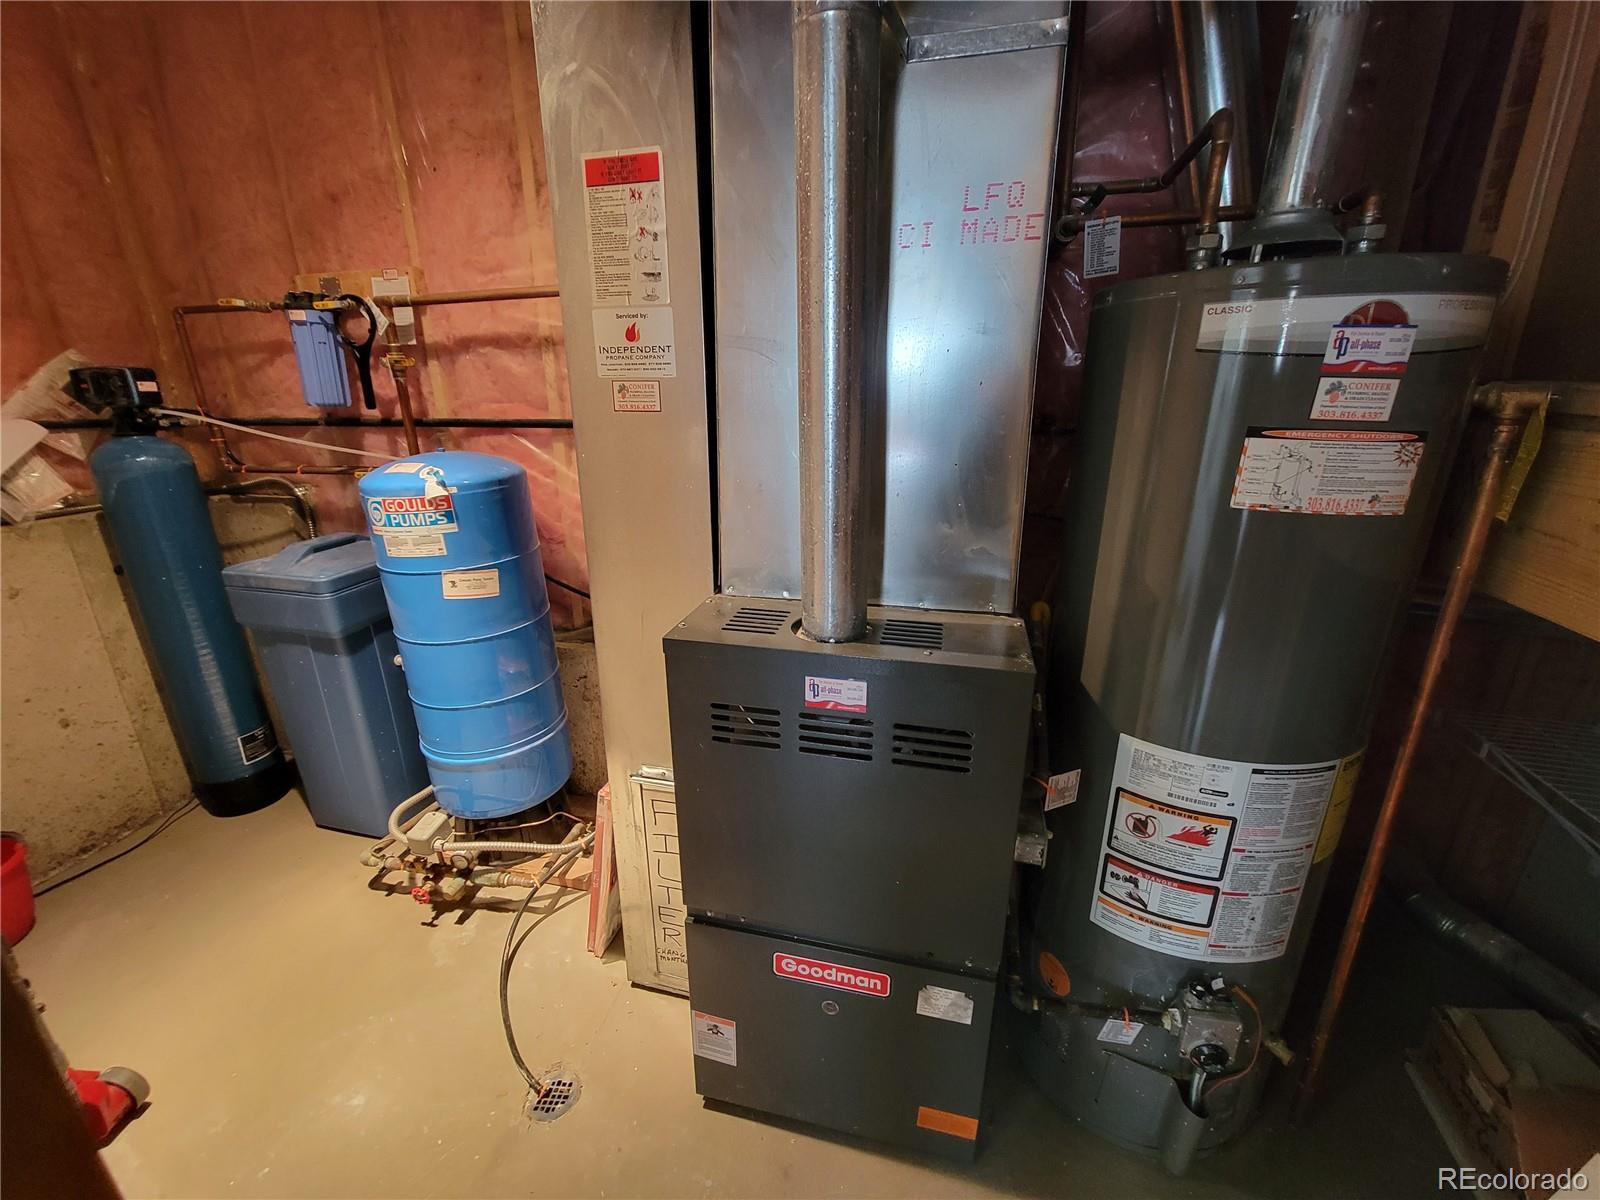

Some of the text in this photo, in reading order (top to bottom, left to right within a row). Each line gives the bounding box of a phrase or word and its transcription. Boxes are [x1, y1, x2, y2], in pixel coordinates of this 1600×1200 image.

[960, 214, 1044, 245] MADE
[1207, 304, 1252, 315] CLASSIC
[599, 345, 672, 354] INDEPENDENT
[1348, 382, 1392, 391] CONIFER
[1317, 410, 1383, 419] 303.816.4337
[1286, 431, 1404, 440] EMERGENCY SHUTDOWN
[385, 497, 448, 511] GOULDS
[390, 512, 448, 527] PUMPS
[1158, 807, 1200, 821] WARNING
[1144, 873, 1178, 888] DANGER
[1138, 916, 1172, 930] WARNING
[781, 958, 882, 990] Goodman
